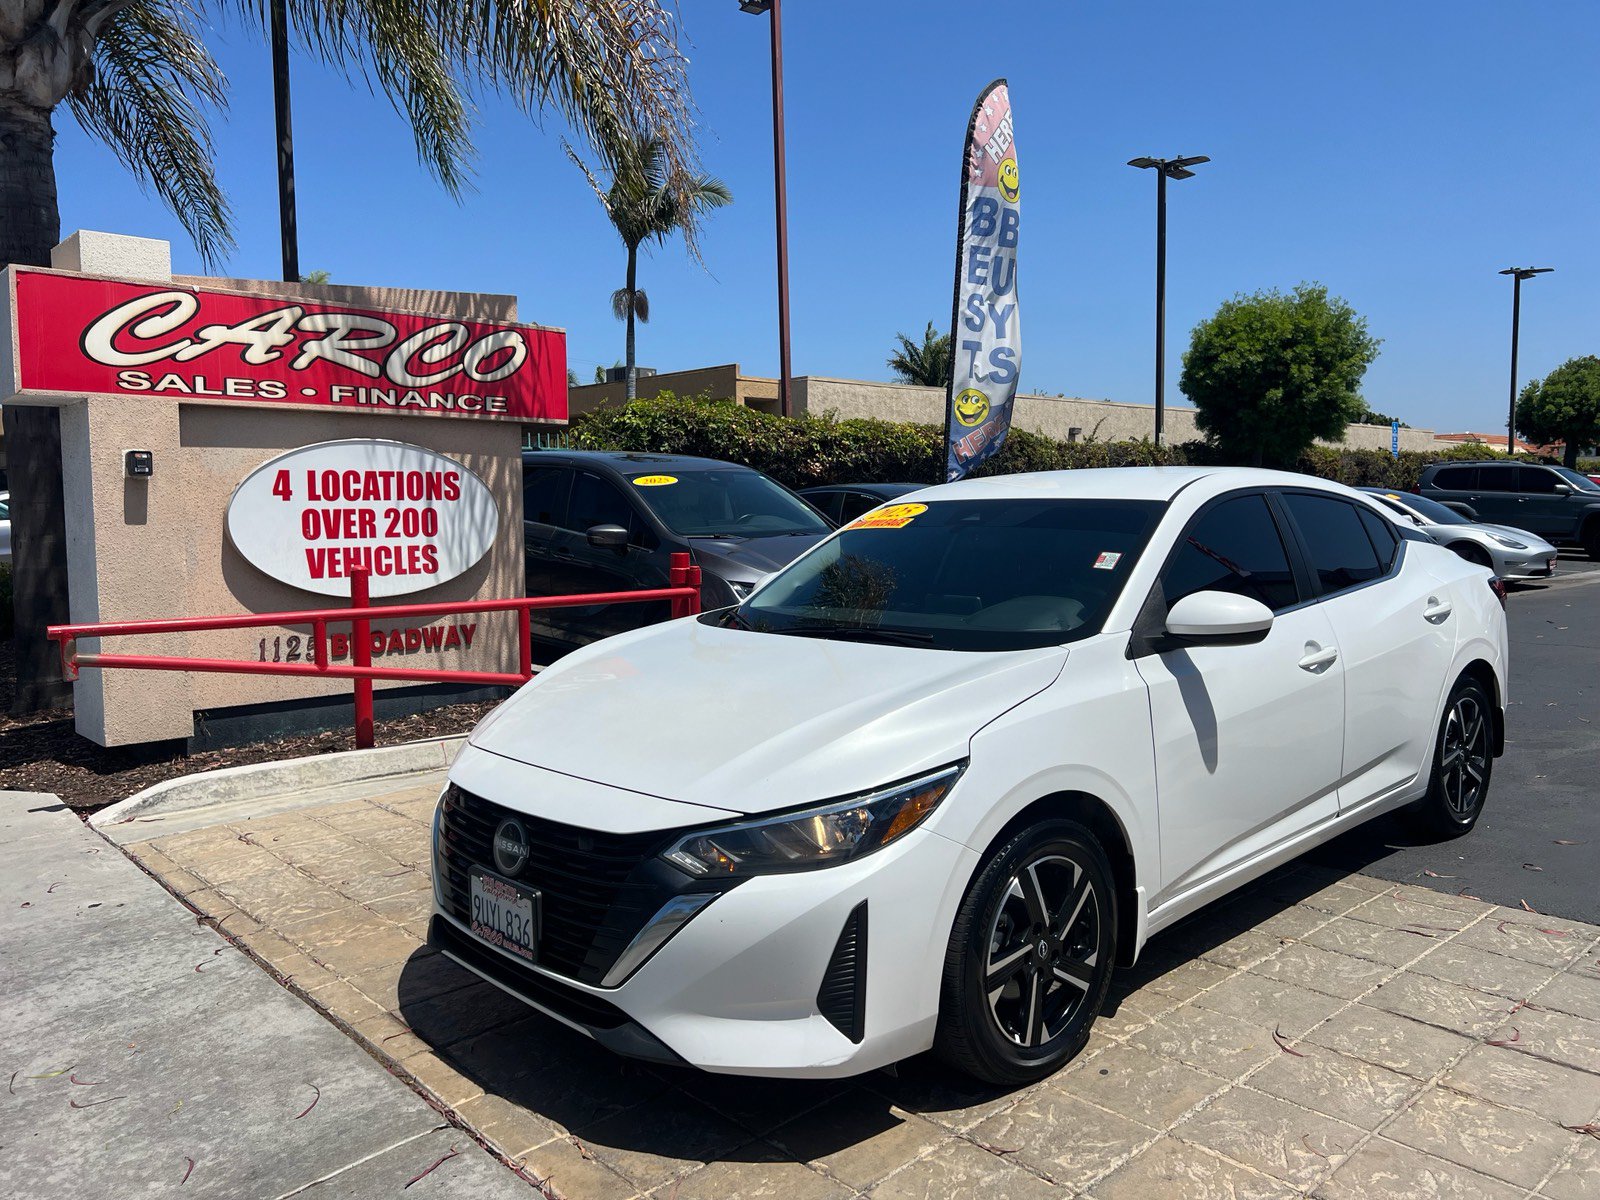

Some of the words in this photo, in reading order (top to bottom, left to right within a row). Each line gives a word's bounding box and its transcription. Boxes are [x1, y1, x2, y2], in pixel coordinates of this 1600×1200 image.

[79, 290, 528, 388] CARCO
[115, 369, 288, 400] SALES
[329, 384, 509, 414] FINANCE
[272, 469, 293, 501] 4
[307, 470, 461, 501] LOCATIONS
[301, 508, 377, 540] OVER
[384, 507, 438, 538] 200
[305, 544, 439, 579] VEHICLES
[331, 623, 477, 661] BOADWAY
[495, 838, 527, 856] NISSAN
